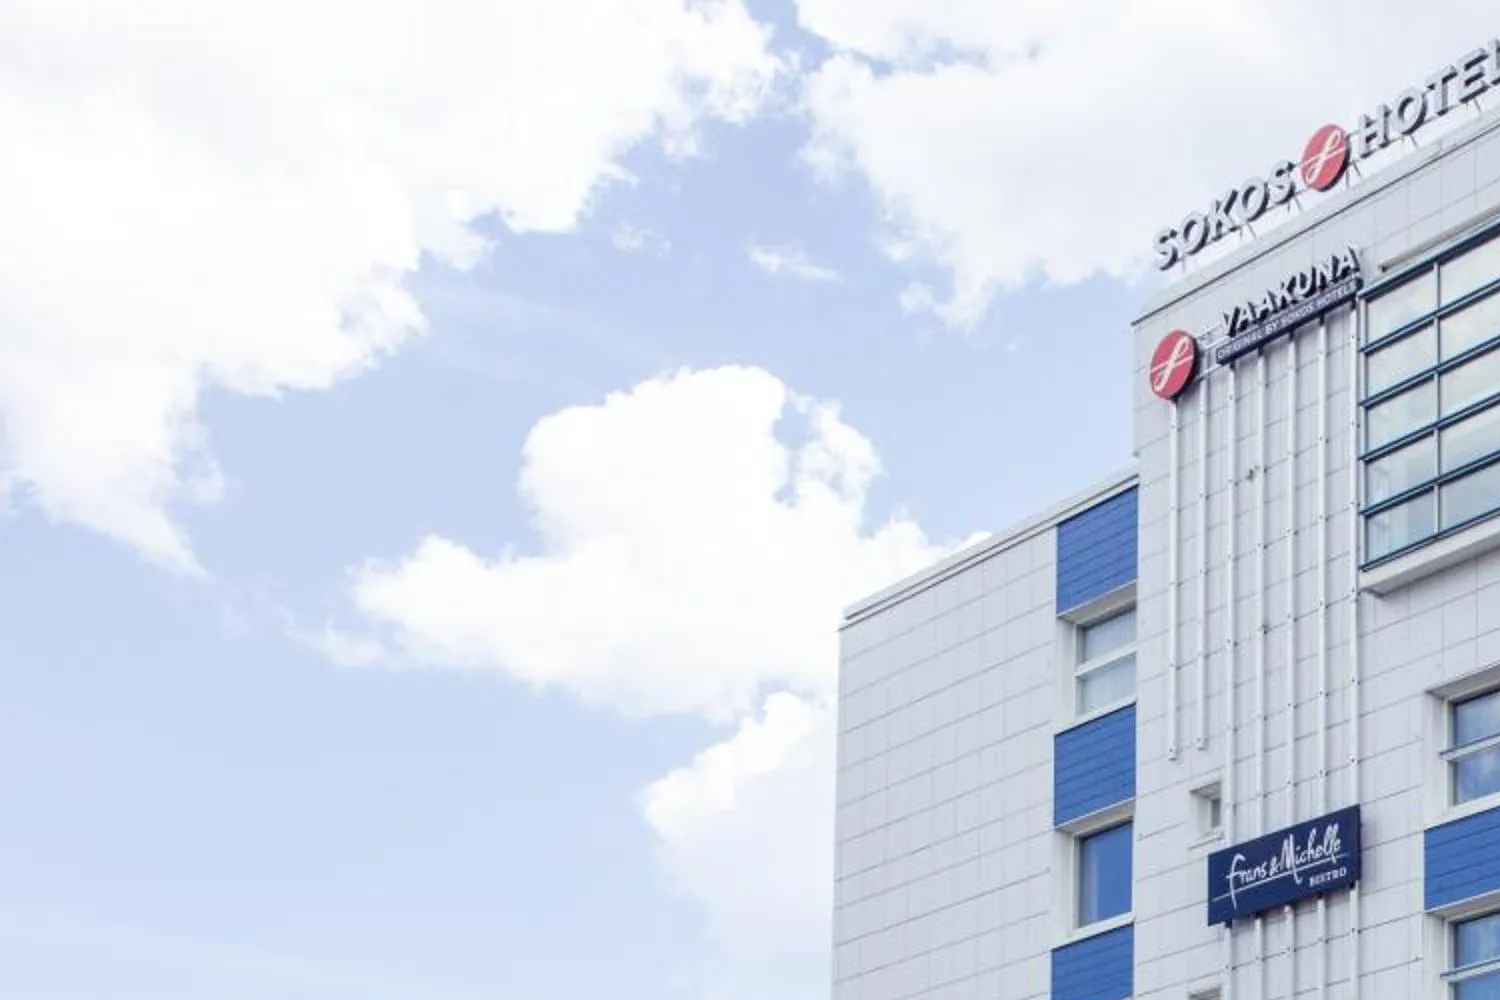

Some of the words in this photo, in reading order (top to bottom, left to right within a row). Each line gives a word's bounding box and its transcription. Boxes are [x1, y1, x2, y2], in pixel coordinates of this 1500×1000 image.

[1151, 160, 1296, 271] SOKOS
[1221, 241, 1361, 338] VAAKUNA
[1278, 822, 1342, 885] Michelle
[1309, 867, 1347, 886] BISTRO
